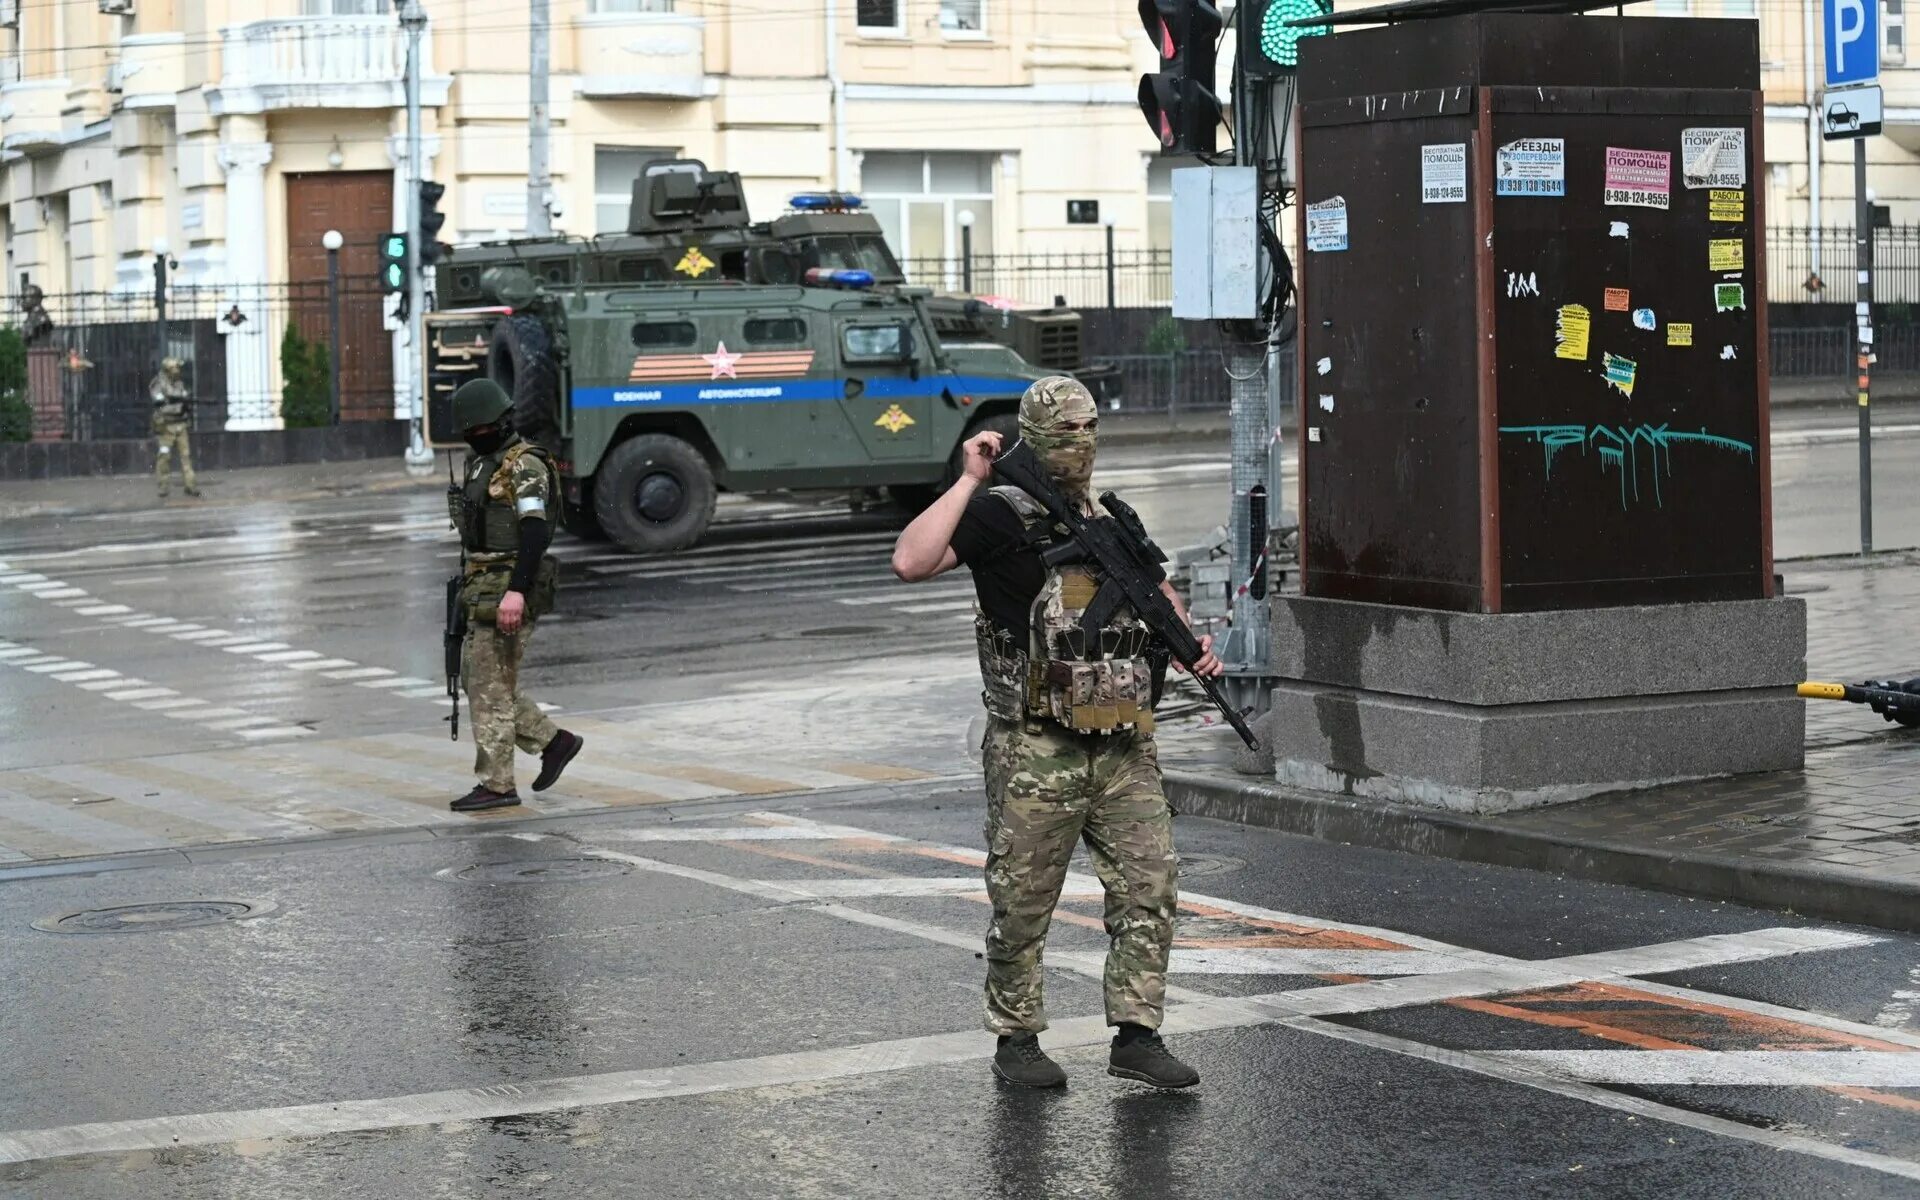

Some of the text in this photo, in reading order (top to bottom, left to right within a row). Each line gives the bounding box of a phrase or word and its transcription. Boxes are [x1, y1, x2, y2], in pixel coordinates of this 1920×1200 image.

[1834, 0, 1865, 73] P
[1423, 146, 1464, 155] БЕСПЛАТНАЯ
[1608, 150, 1667, 161] БЕСПЛАТНАЯ
[1423, 154, 1464, 164] ПОМОЩЬ
[1608, 157, 1667, 170] ПОМОЩЬ
[1499, 179, 1505, 192] 8
[1507, 180, 1522, 192] 938
[1541, 180, 1561, 193] 9644
[1605, 189, 1668, 206] 8-938-124-9555
[1712, 191, 1741, 200] РАБОТА
[613, 386, 783, 402] ВОЕННАЯ АВТОИНСПЕКЦИЯ
